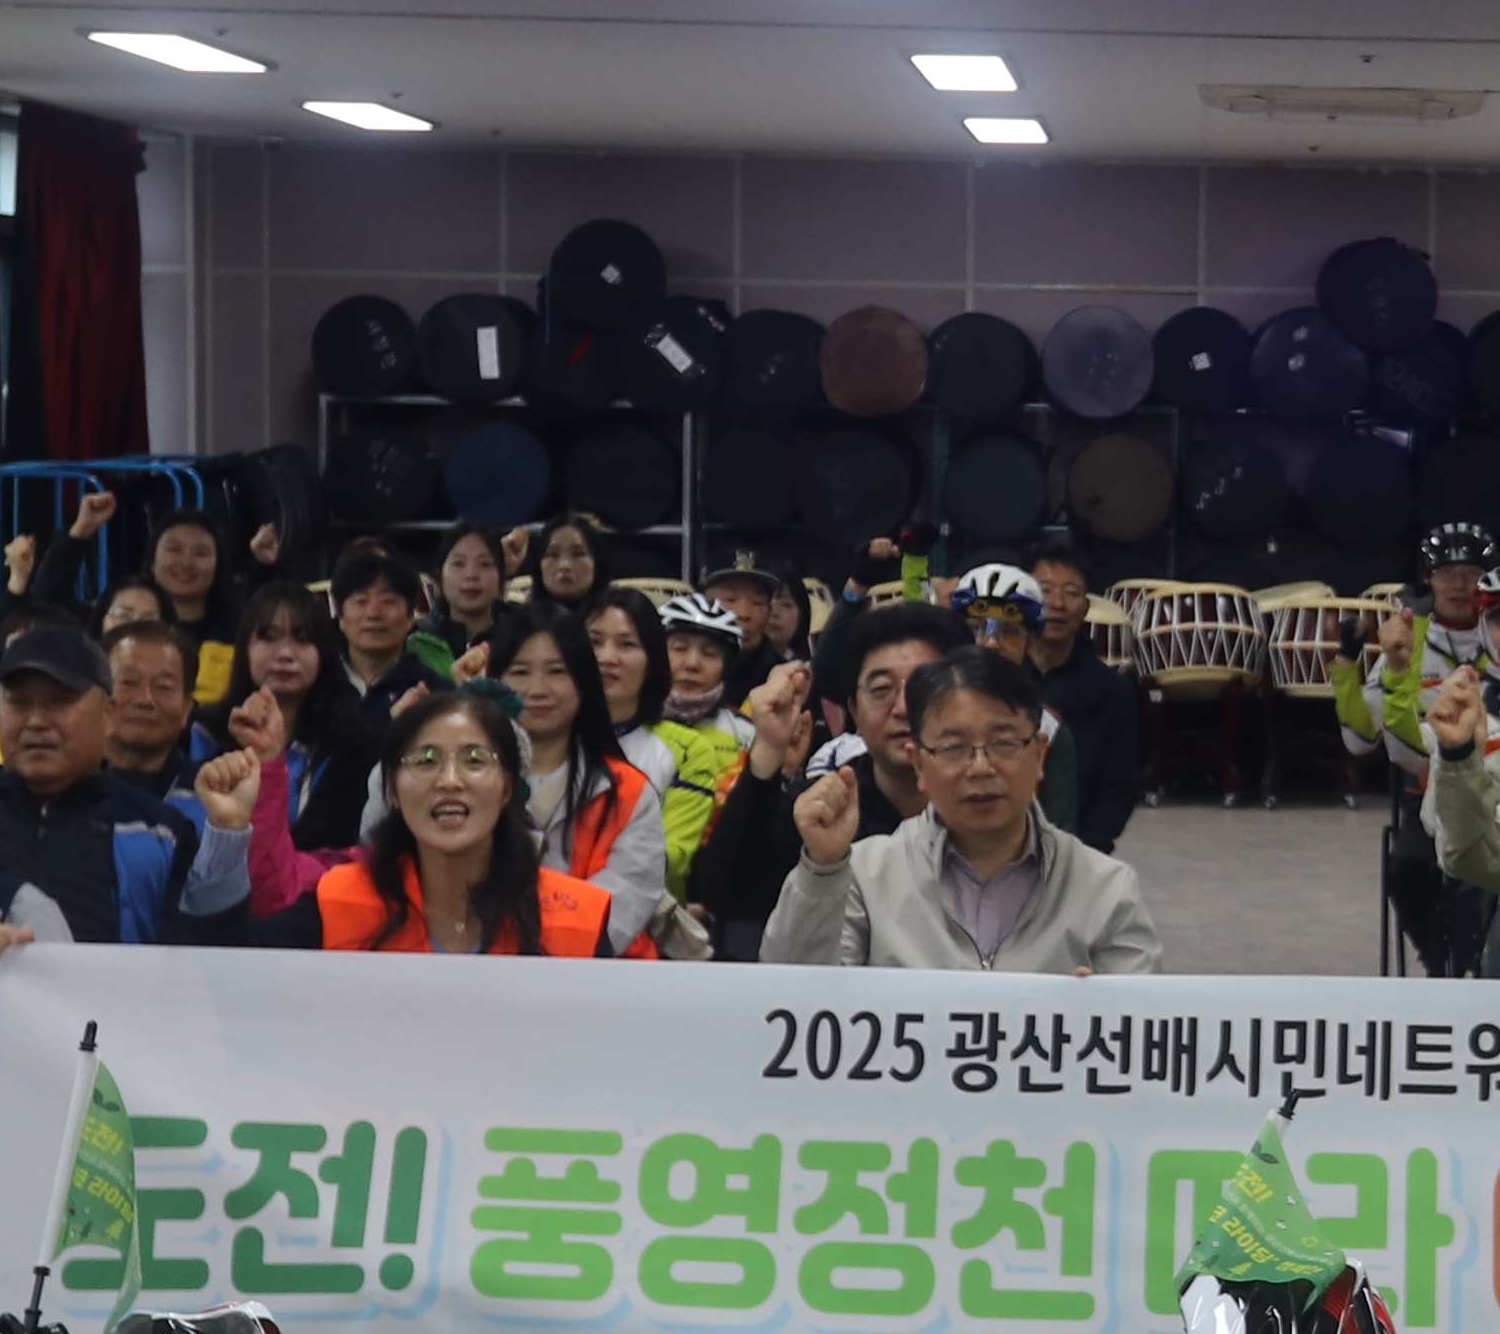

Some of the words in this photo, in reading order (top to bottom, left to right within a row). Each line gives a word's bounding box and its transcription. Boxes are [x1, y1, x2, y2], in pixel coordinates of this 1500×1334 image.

[762, 1008, 927, 1084] 2025
[62, 1117, 428, 1299] 도전!
[468, 1126, 1097, 1322] 풍영정천
